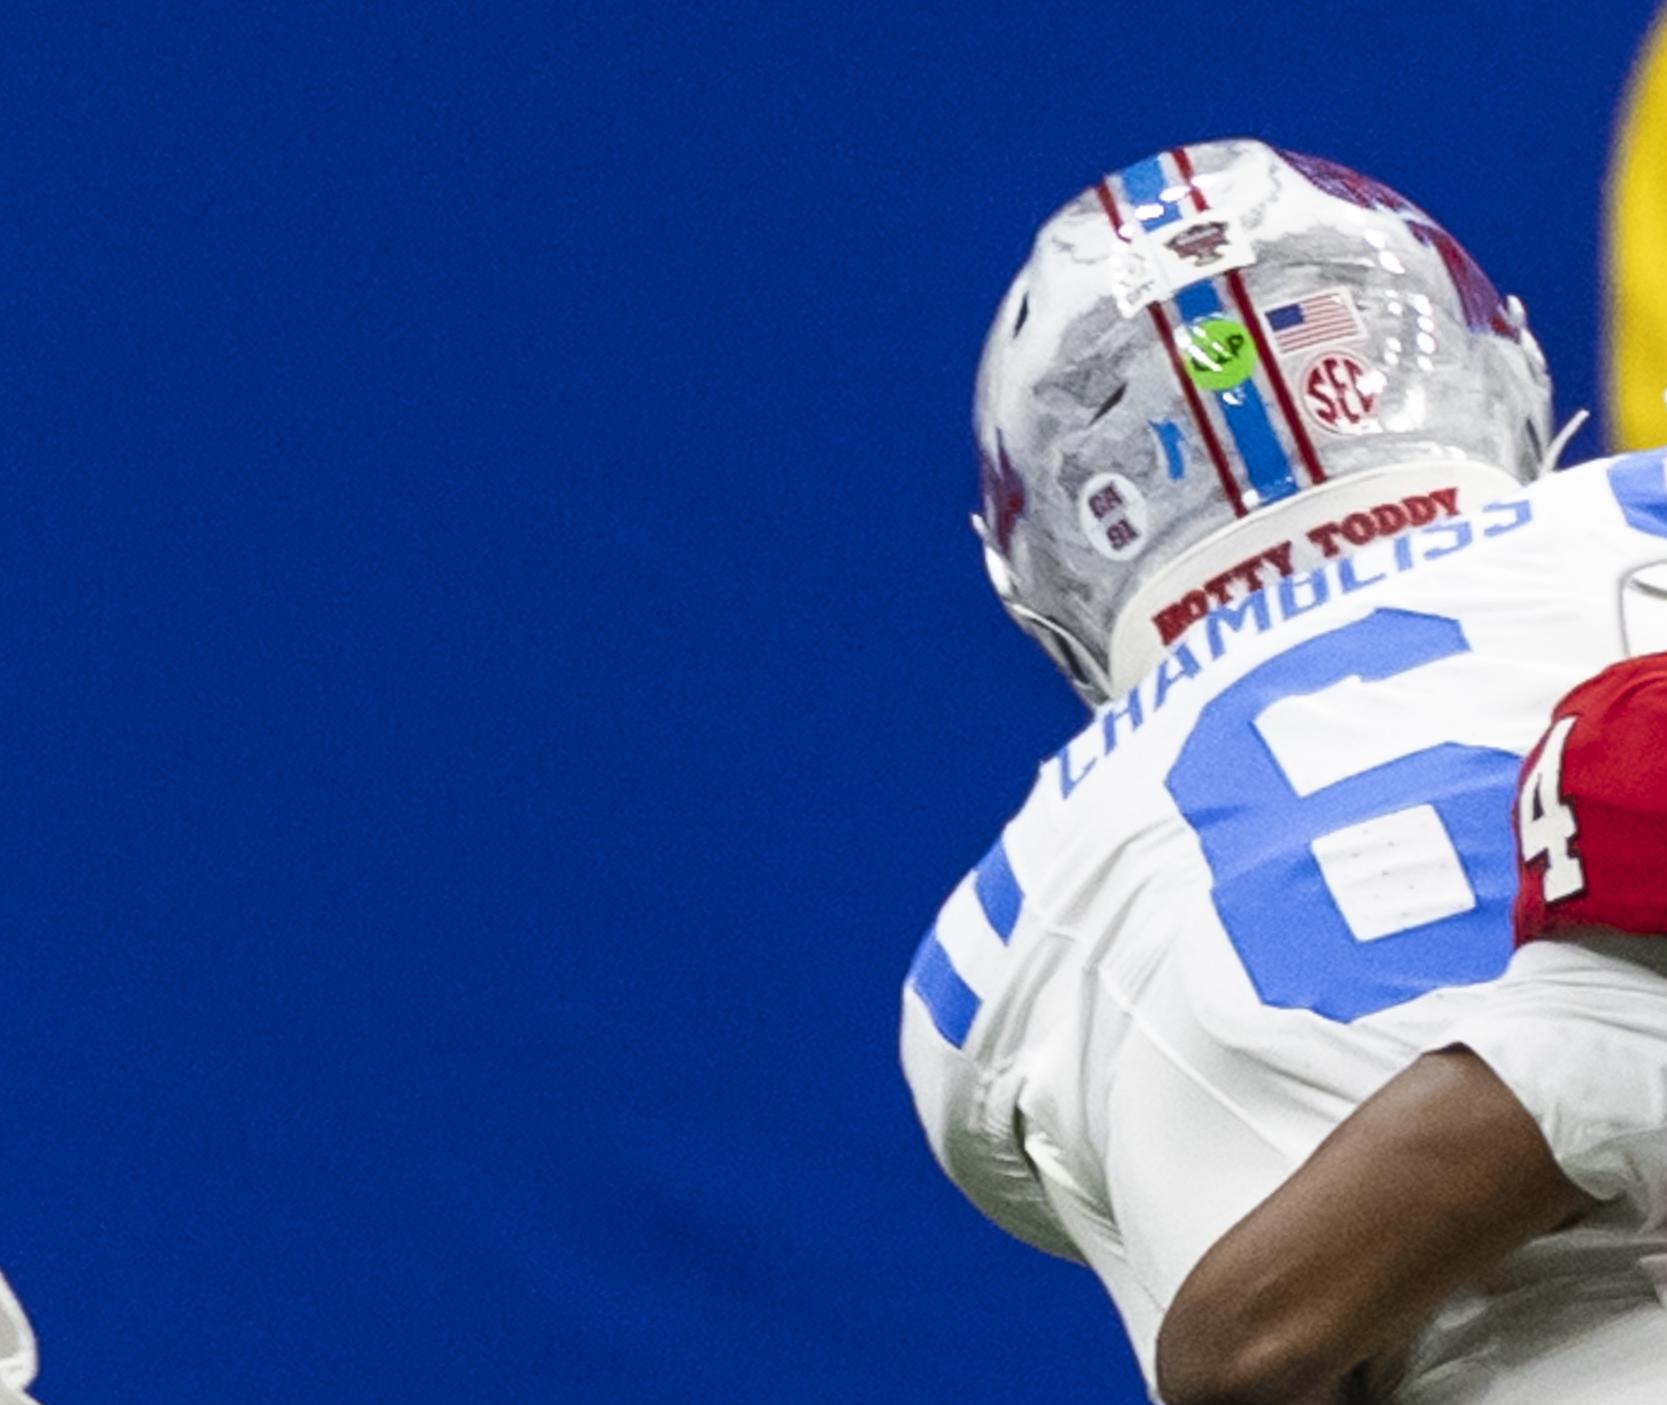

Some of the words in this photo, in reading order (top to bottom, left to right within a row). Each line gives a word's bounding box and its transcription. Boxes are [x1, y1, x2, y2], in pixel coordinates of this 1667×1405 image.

[1307, 357, 1377, 425] SEC
[1307, 486, 1461, 558] TODDY
[1163, 607, 1524, 1025] 6
[1518, 714, 1588, 904] 4
